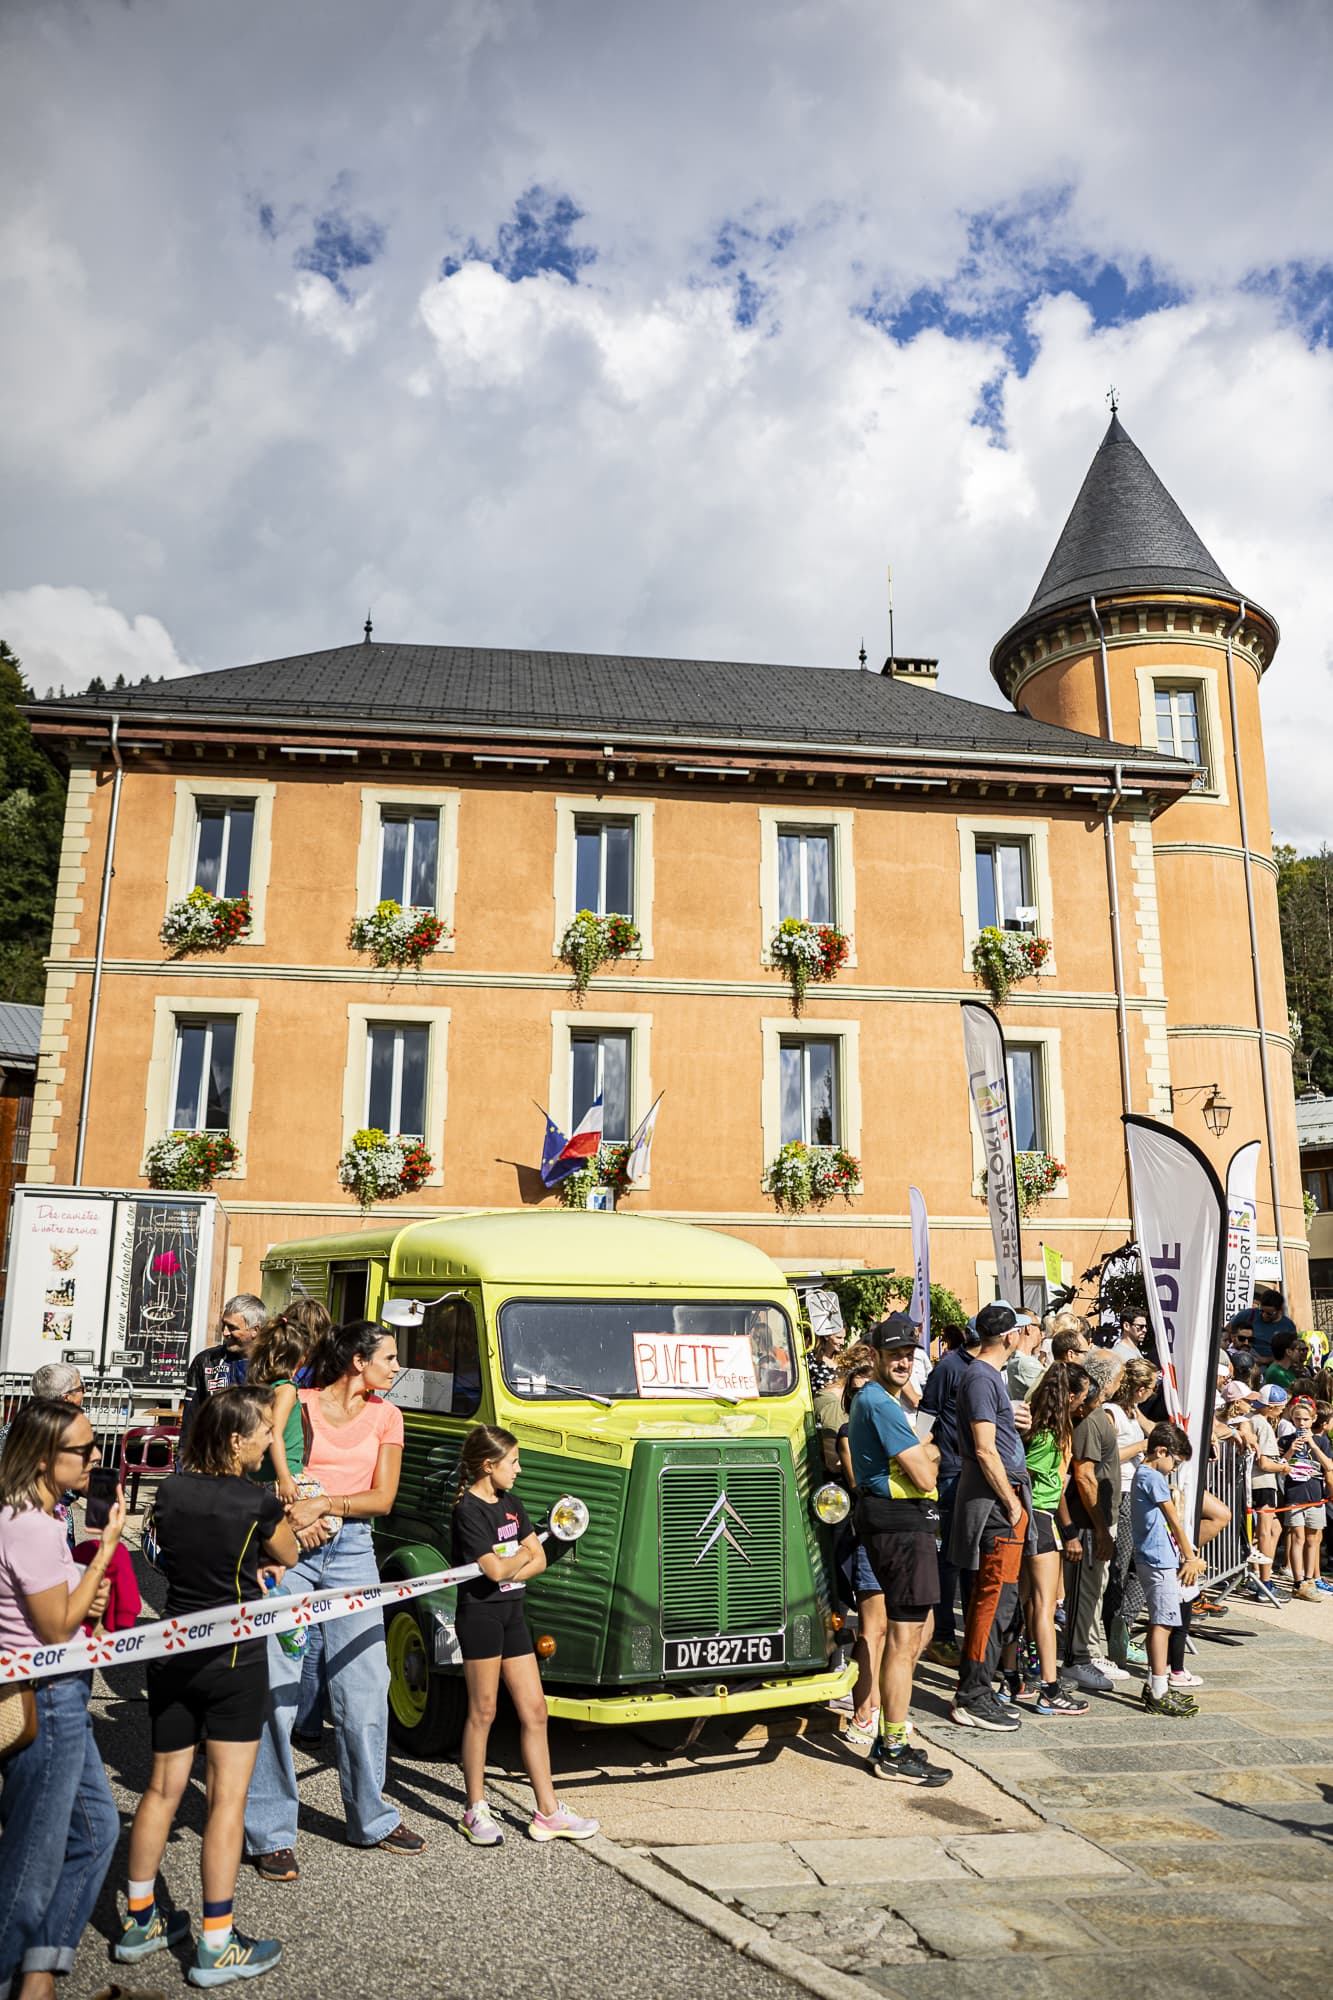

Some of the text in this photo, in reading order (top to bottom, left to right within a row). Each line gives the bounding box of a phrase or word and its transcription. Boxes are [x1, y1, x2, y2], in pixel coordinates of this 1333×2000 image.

[1226, 1263, 1237, 1322] RECHES
[1238, 1235, 1251, 1312] EAUFORT
[637, 1343, 729, 1384] BUVETTE
[497, 1521, 518, 1541] PUMA
[677, 1637, 772, 1668] DV-827-FG
